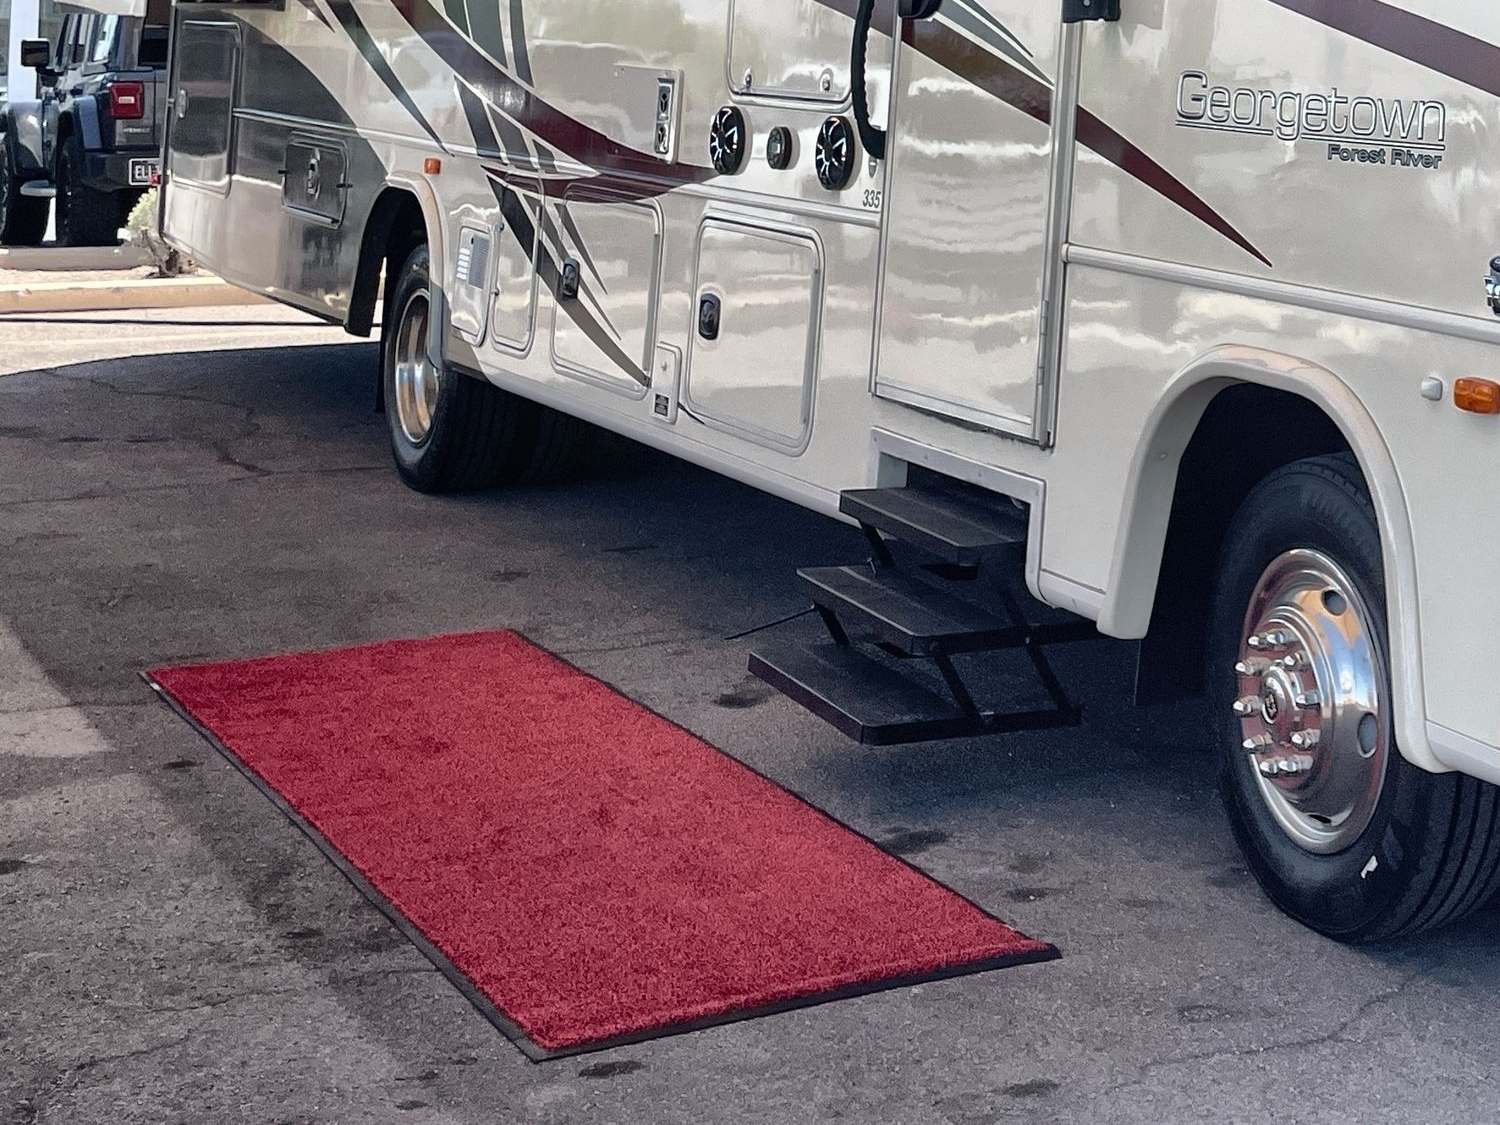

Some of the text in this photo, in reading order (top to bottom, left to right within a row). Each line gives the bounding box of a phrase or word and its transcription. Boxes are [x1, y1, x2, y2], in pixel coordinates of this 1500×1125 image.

[1175, 70, 1446, 141] Georgetown
[1327, 143, 1442, 169] Forest River
[862, 189, 881, 209] 335
